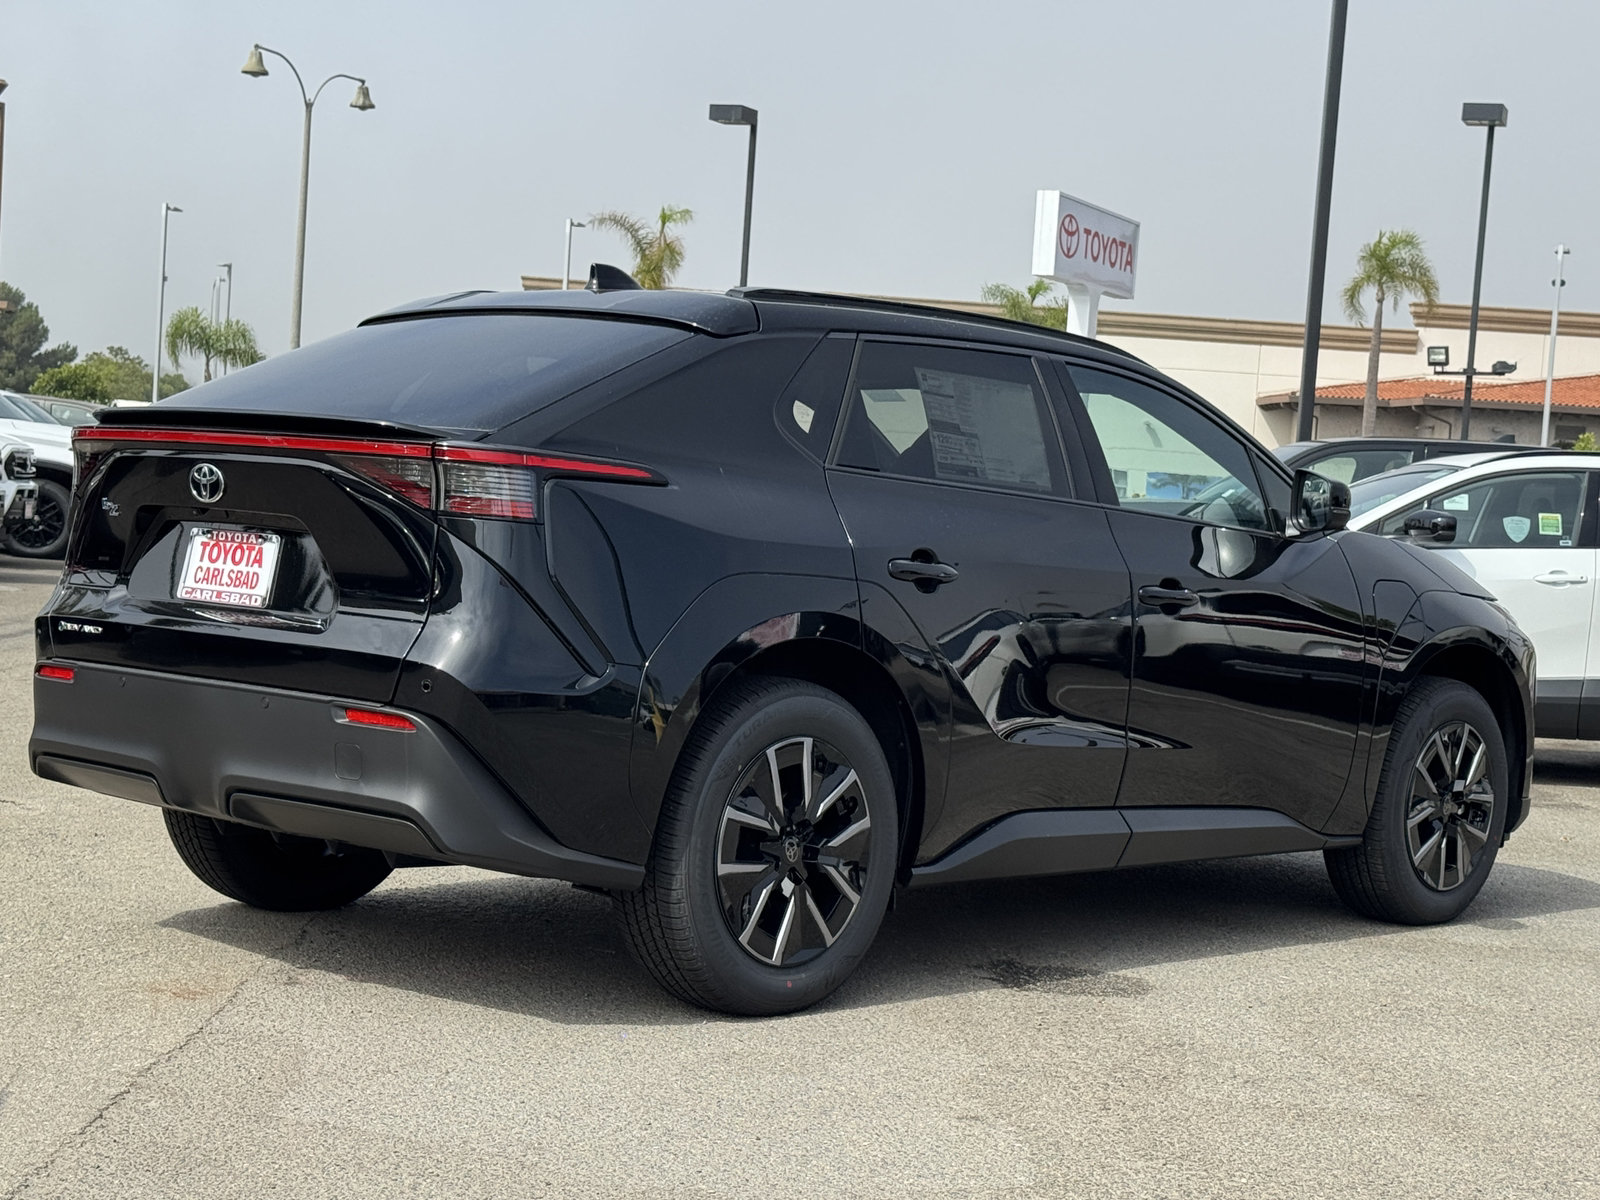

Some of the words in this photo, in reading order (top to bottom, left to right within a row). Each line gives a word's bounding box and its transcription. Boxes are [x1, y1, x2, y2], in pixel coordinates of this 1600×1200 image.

[1083, 227, 1133, 274] TOYOTA
[212, 530, 257, 544] TOYOTA
[199, 541, 264, 568] TOYOTA
[193, 565, 260, 590] CARLSBAD
[181, 587, 264, 607] CARLSBAD
